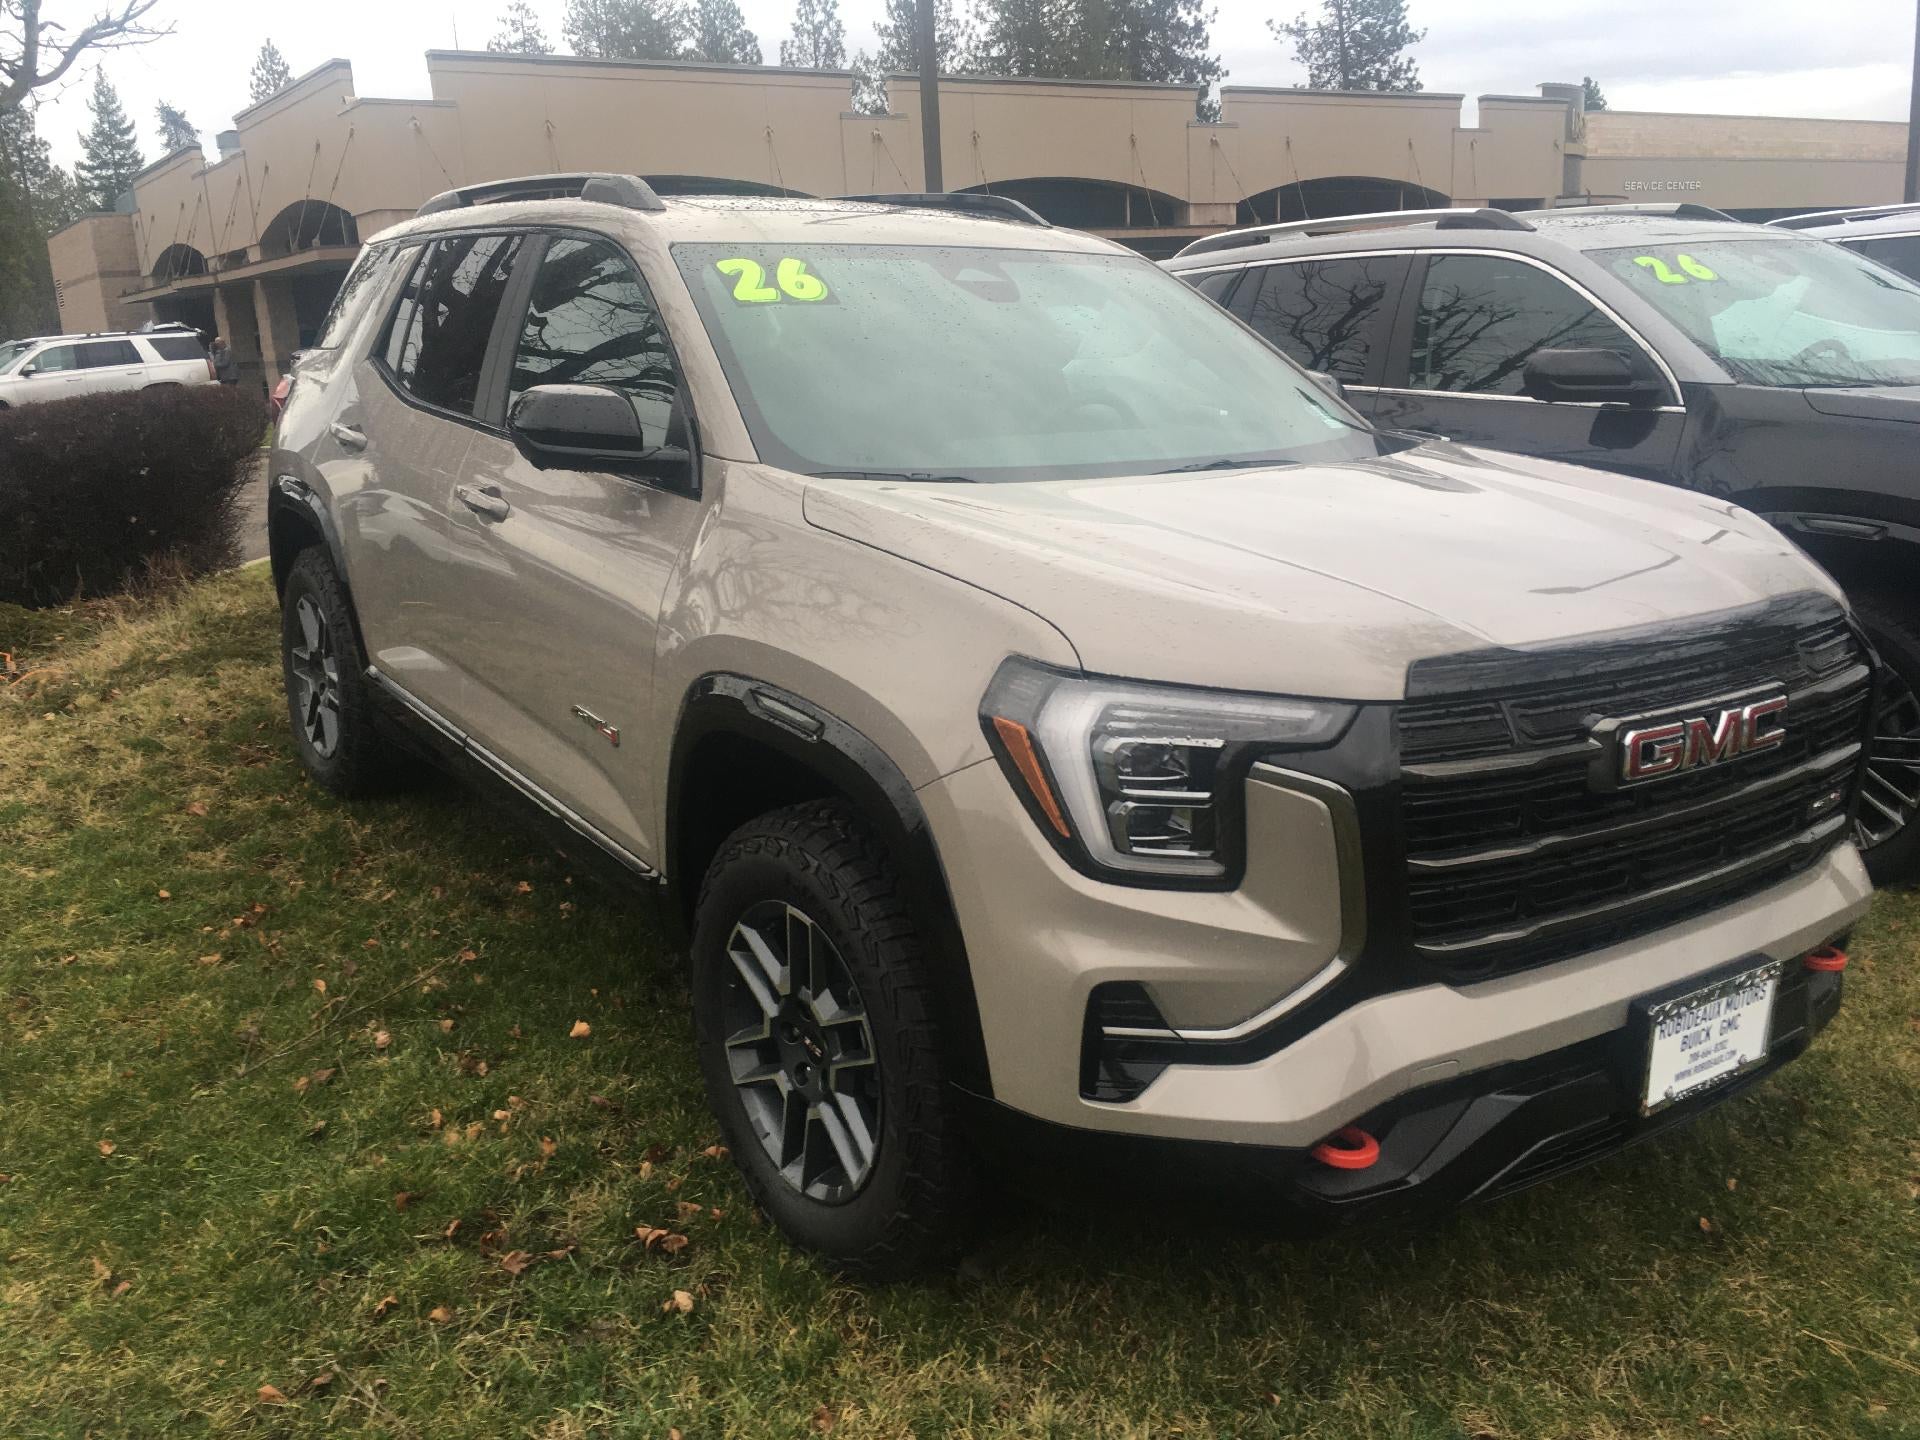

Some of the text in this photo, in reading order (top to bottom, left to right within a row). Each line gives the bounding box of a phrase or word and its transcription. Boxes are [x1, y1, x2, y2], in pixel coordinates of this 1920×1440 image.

[1624, 181, 1701, 191] SERVICE CENTER
[716, 257, 828, 302] 26
[1633, 254, 1719, 284] 26
[1624, 694, 1788, 780] GMC
[1724, 983, 1767, 1015] MOTORS
[1680, 1025, 1712, 1052] BUICK
[1720, 1013, 1741, 1036] GMC
